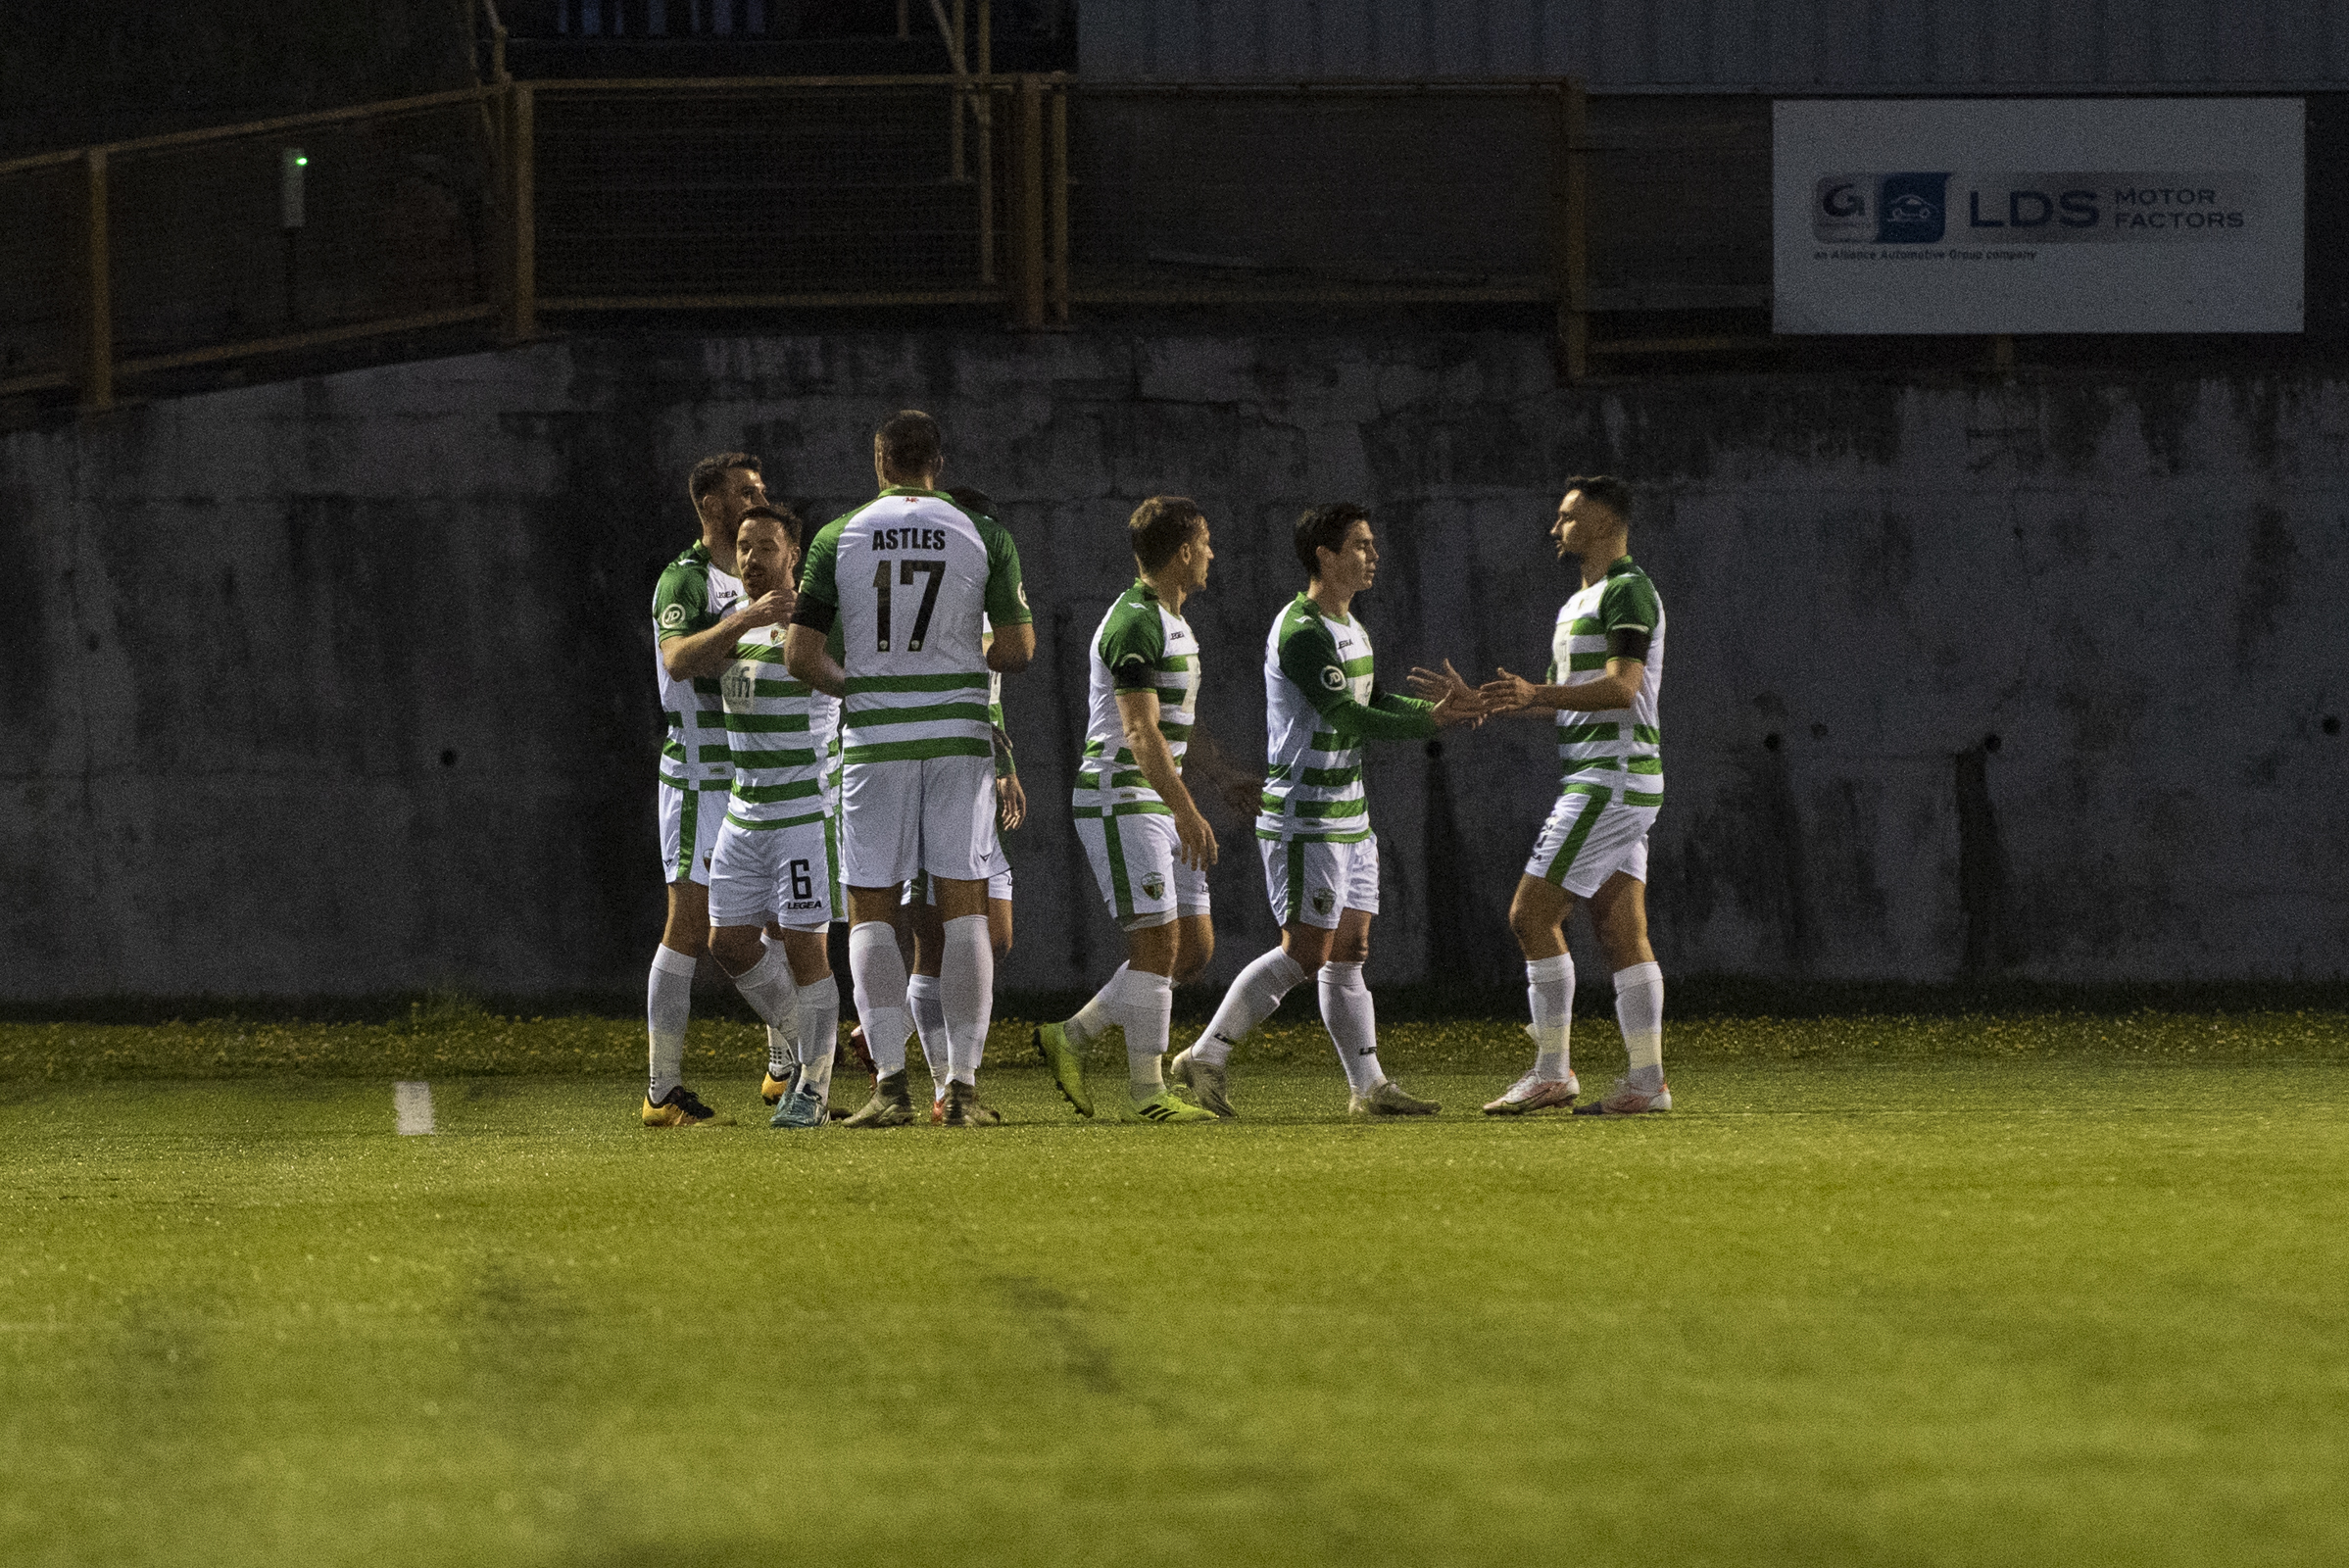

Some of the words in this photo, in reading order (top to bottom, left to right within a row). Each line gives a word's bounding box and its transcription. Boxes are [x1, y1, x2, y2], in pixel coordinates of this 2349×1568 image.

[2115, 188, 2215, 206] MOTOR
[1969, 190, 2100, 228] LDS
[2115, 212, 2245, 229] FACTORS
[1831, 250, 1877, 260] Alliance
[1881, 250, 1945, 260] Automotive
[1948, 250, 1983, 262] Group
[1986, 251, 2037, 262] company
[871, 527, 946, 551] ASTLES
[872, 560, 946, 652] 17
[790, 858, 812, 900] 6
[787, 900, 822, 909] LEGEA
